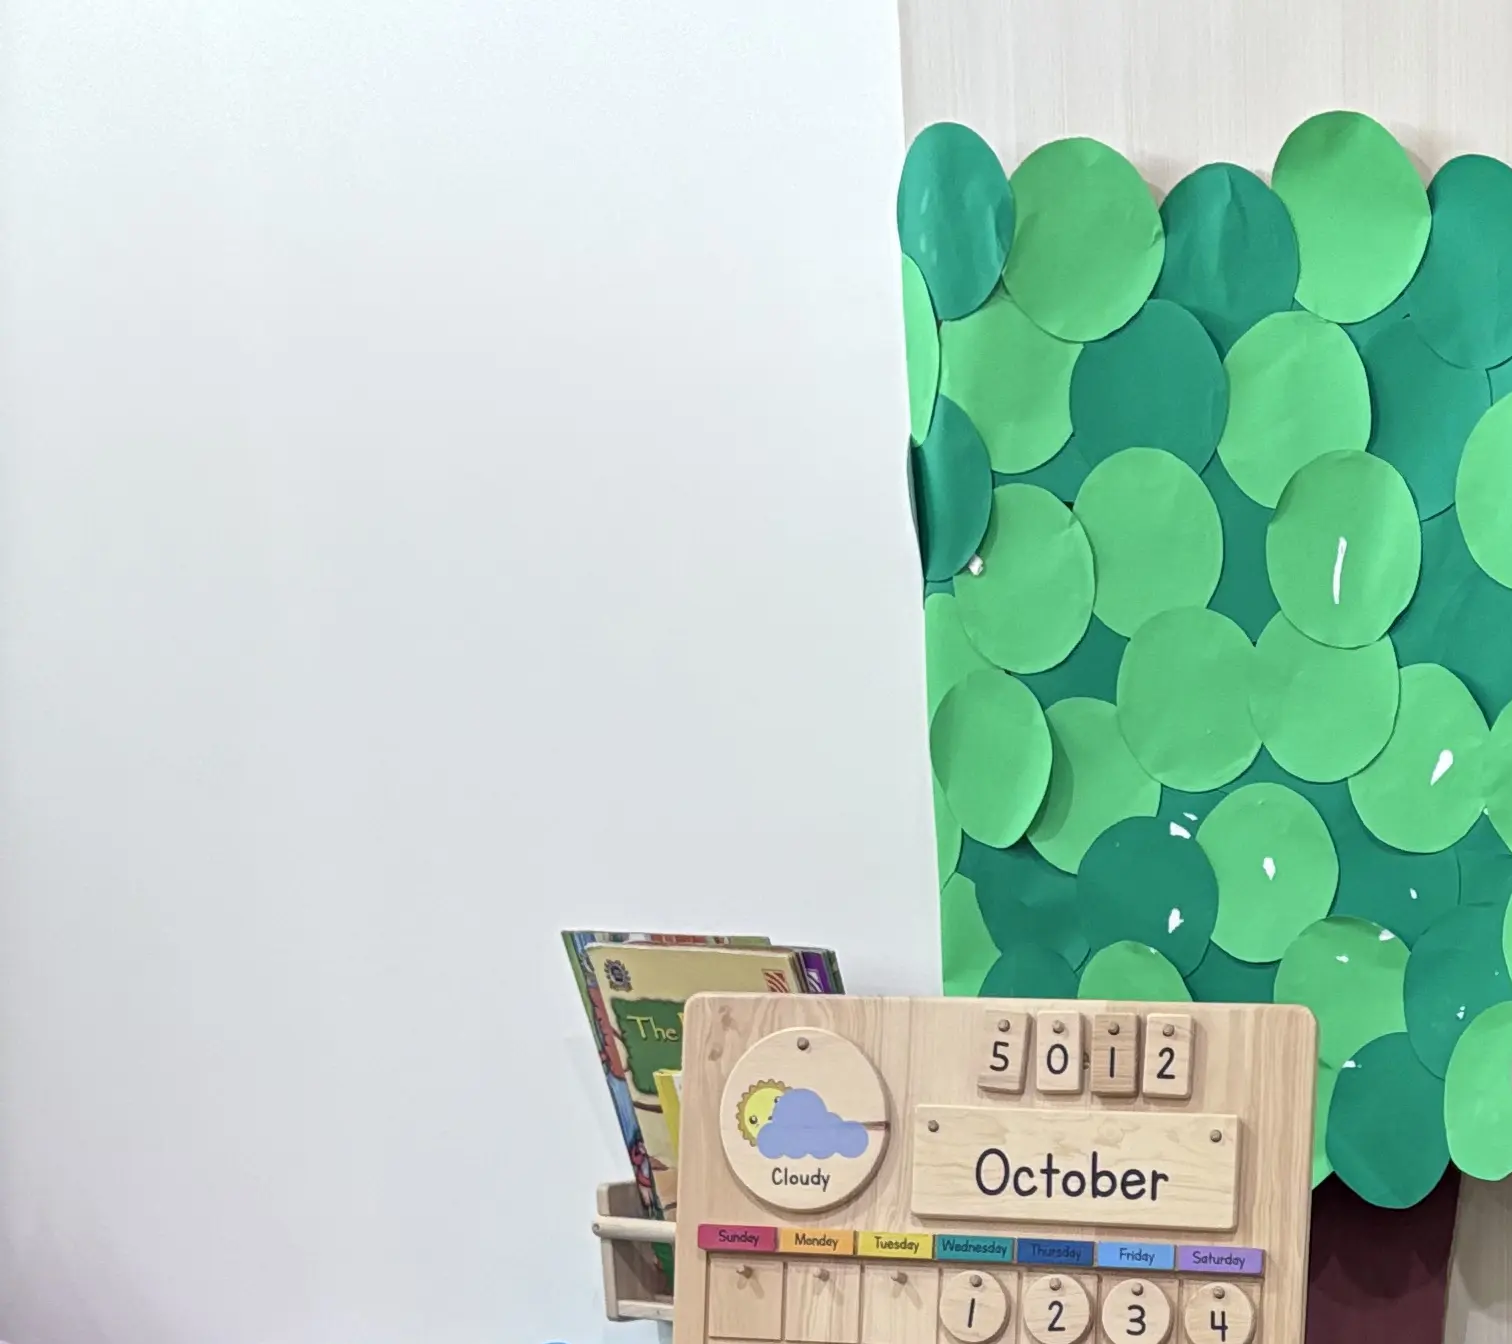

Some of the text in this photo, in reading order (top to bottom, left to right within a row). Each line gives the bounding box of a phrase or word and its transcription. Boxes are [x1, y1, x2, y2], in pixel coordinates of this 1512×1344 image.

[626, 1014, 680, 1043] The
[770, 1166, 831, 1192] Cloudy
[975, 1147, 1169, 1202] October
[718, 1229, 1247, 1270] Sunday Monday Tuesday Wednesday Thursday Friday Saturday
[967, 1297, 1229, 1343] 1 2 3 4
